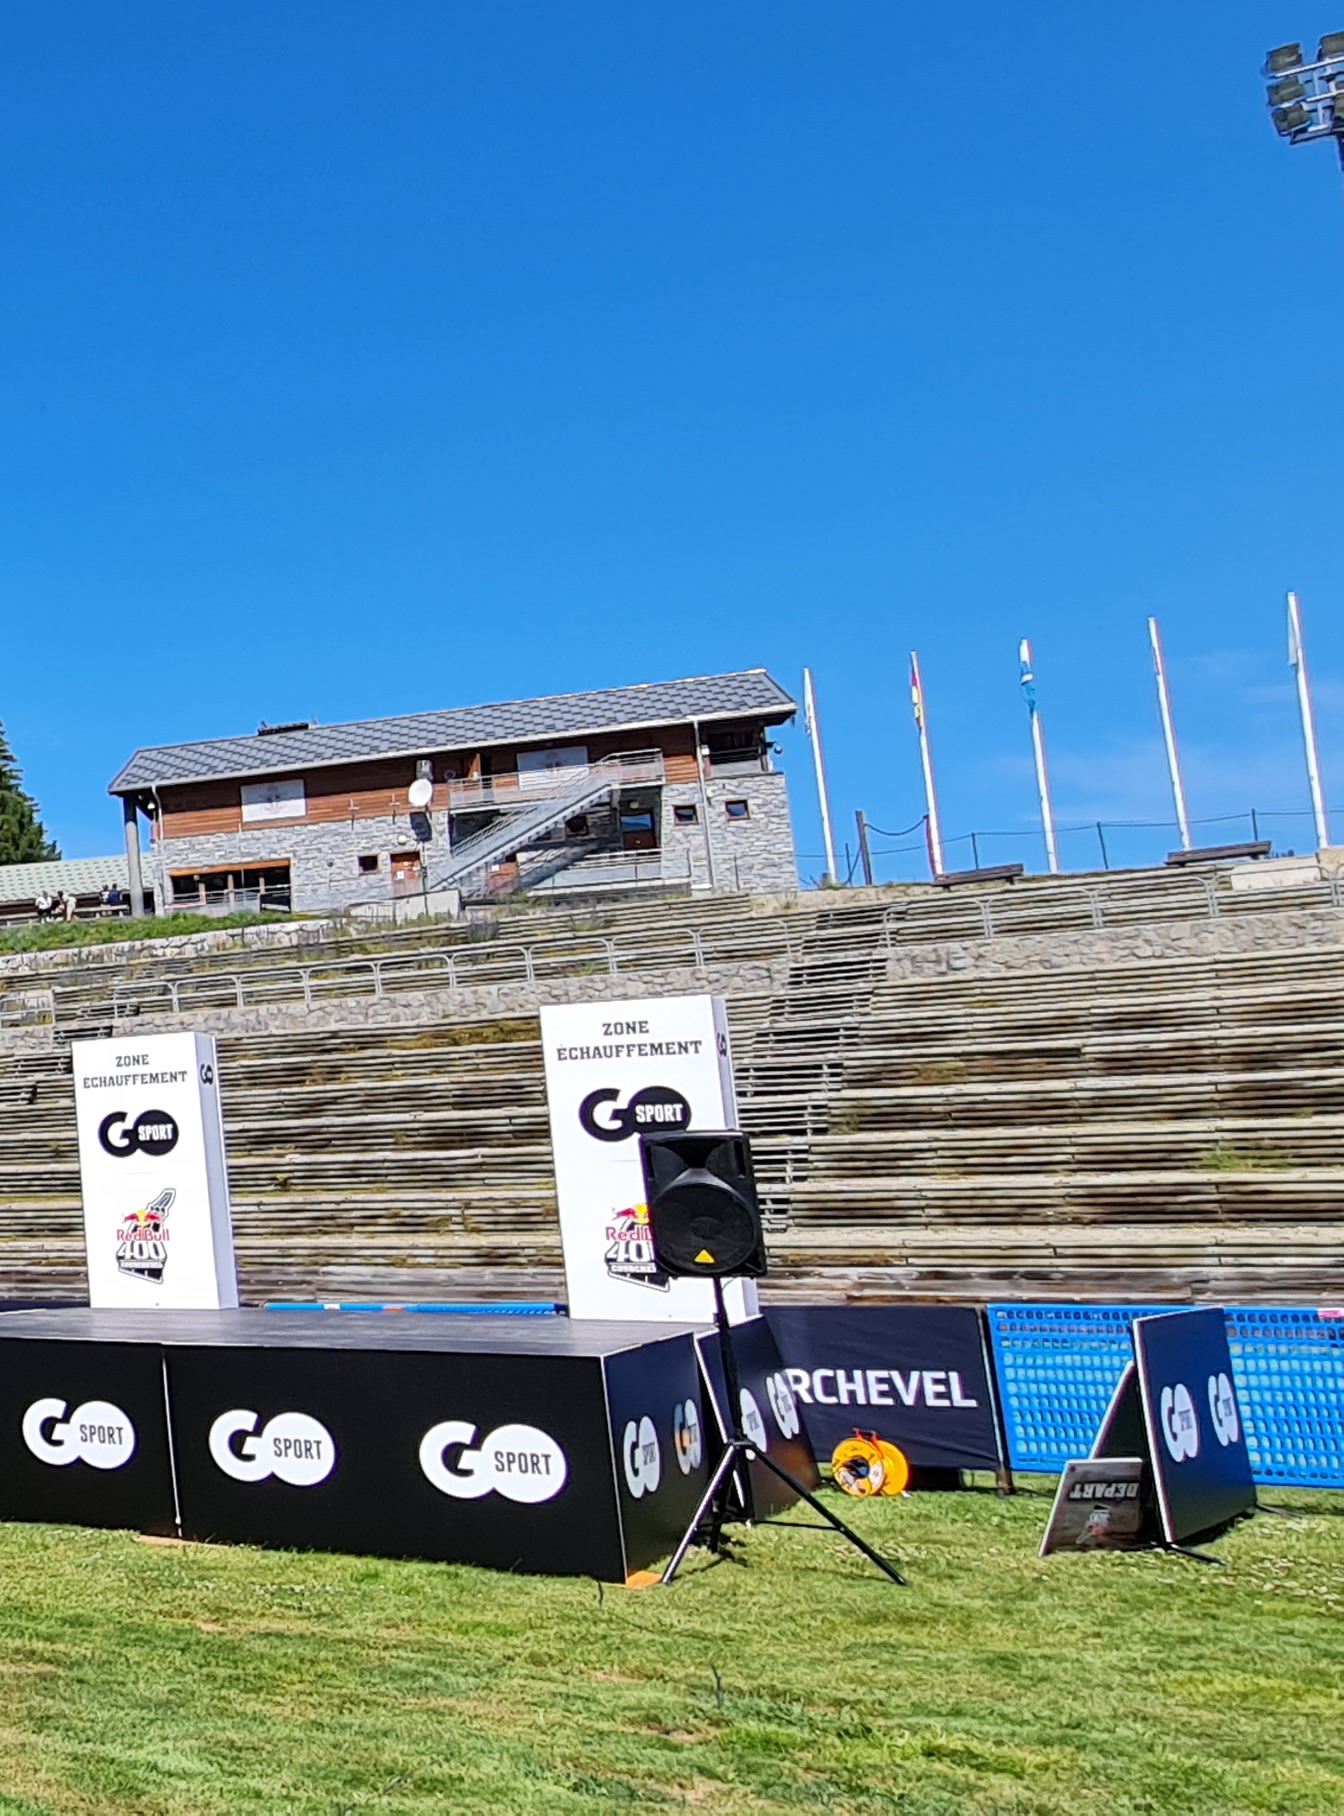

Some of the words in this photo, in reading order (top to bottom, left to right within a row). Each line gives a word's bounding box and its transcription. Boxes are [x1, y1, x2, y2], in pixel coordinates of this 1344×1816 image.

[602, 1020, 650, 1036] ZONE
[115, 1054, 149, 1067] ZONE
[635, 1103, 684, 1123] SPORT
[137, 1124, 174, 1141] SPORT
[605, 1226, 642, 1241] Red
[116, 1240, 168, 1261] 400
[604, 1239, 656, 1262] 40
[784, 1368, 978, 1408] RCHEVEL
[22, 1397, 135, 1470] GO
[79, 1424, 124, 1446] SPORT
[208, 1409, 335, 1487] GO
[273, 1437, 322, 1460] SPORT
[418, 1420, 566, 1503] GO
[494, 1451, 551, 1475] SPORT
